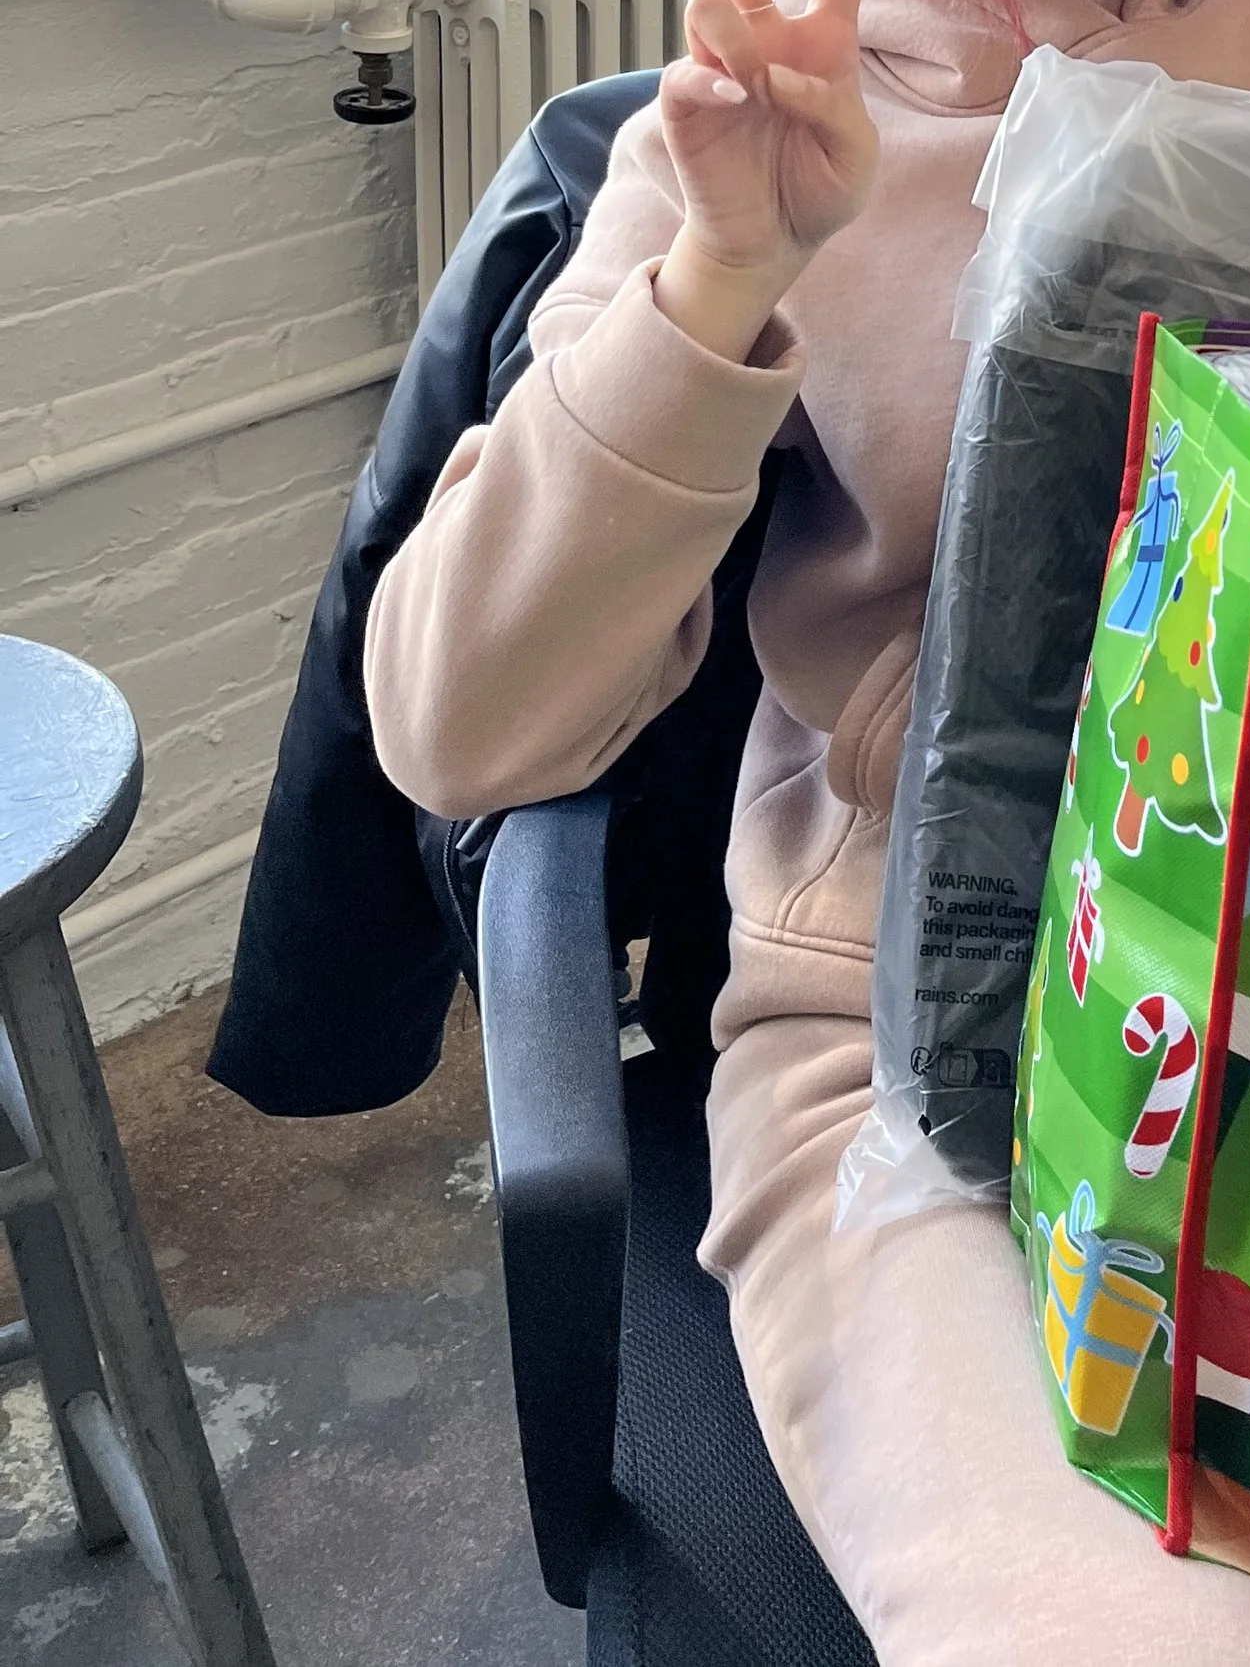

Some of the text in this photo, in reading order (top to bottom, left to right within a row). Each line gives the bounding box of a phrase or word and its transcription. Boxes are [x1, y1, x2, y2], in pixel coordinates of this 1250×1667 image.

[925, 895, 944, 913] To
[947, 900, 993, 916] avoid
[922, 917, 953, 935] this
[920, 942, 952, 958] and
[955, 945, 1001, 961] small
[915, 985, 999, 1005] rains.com
